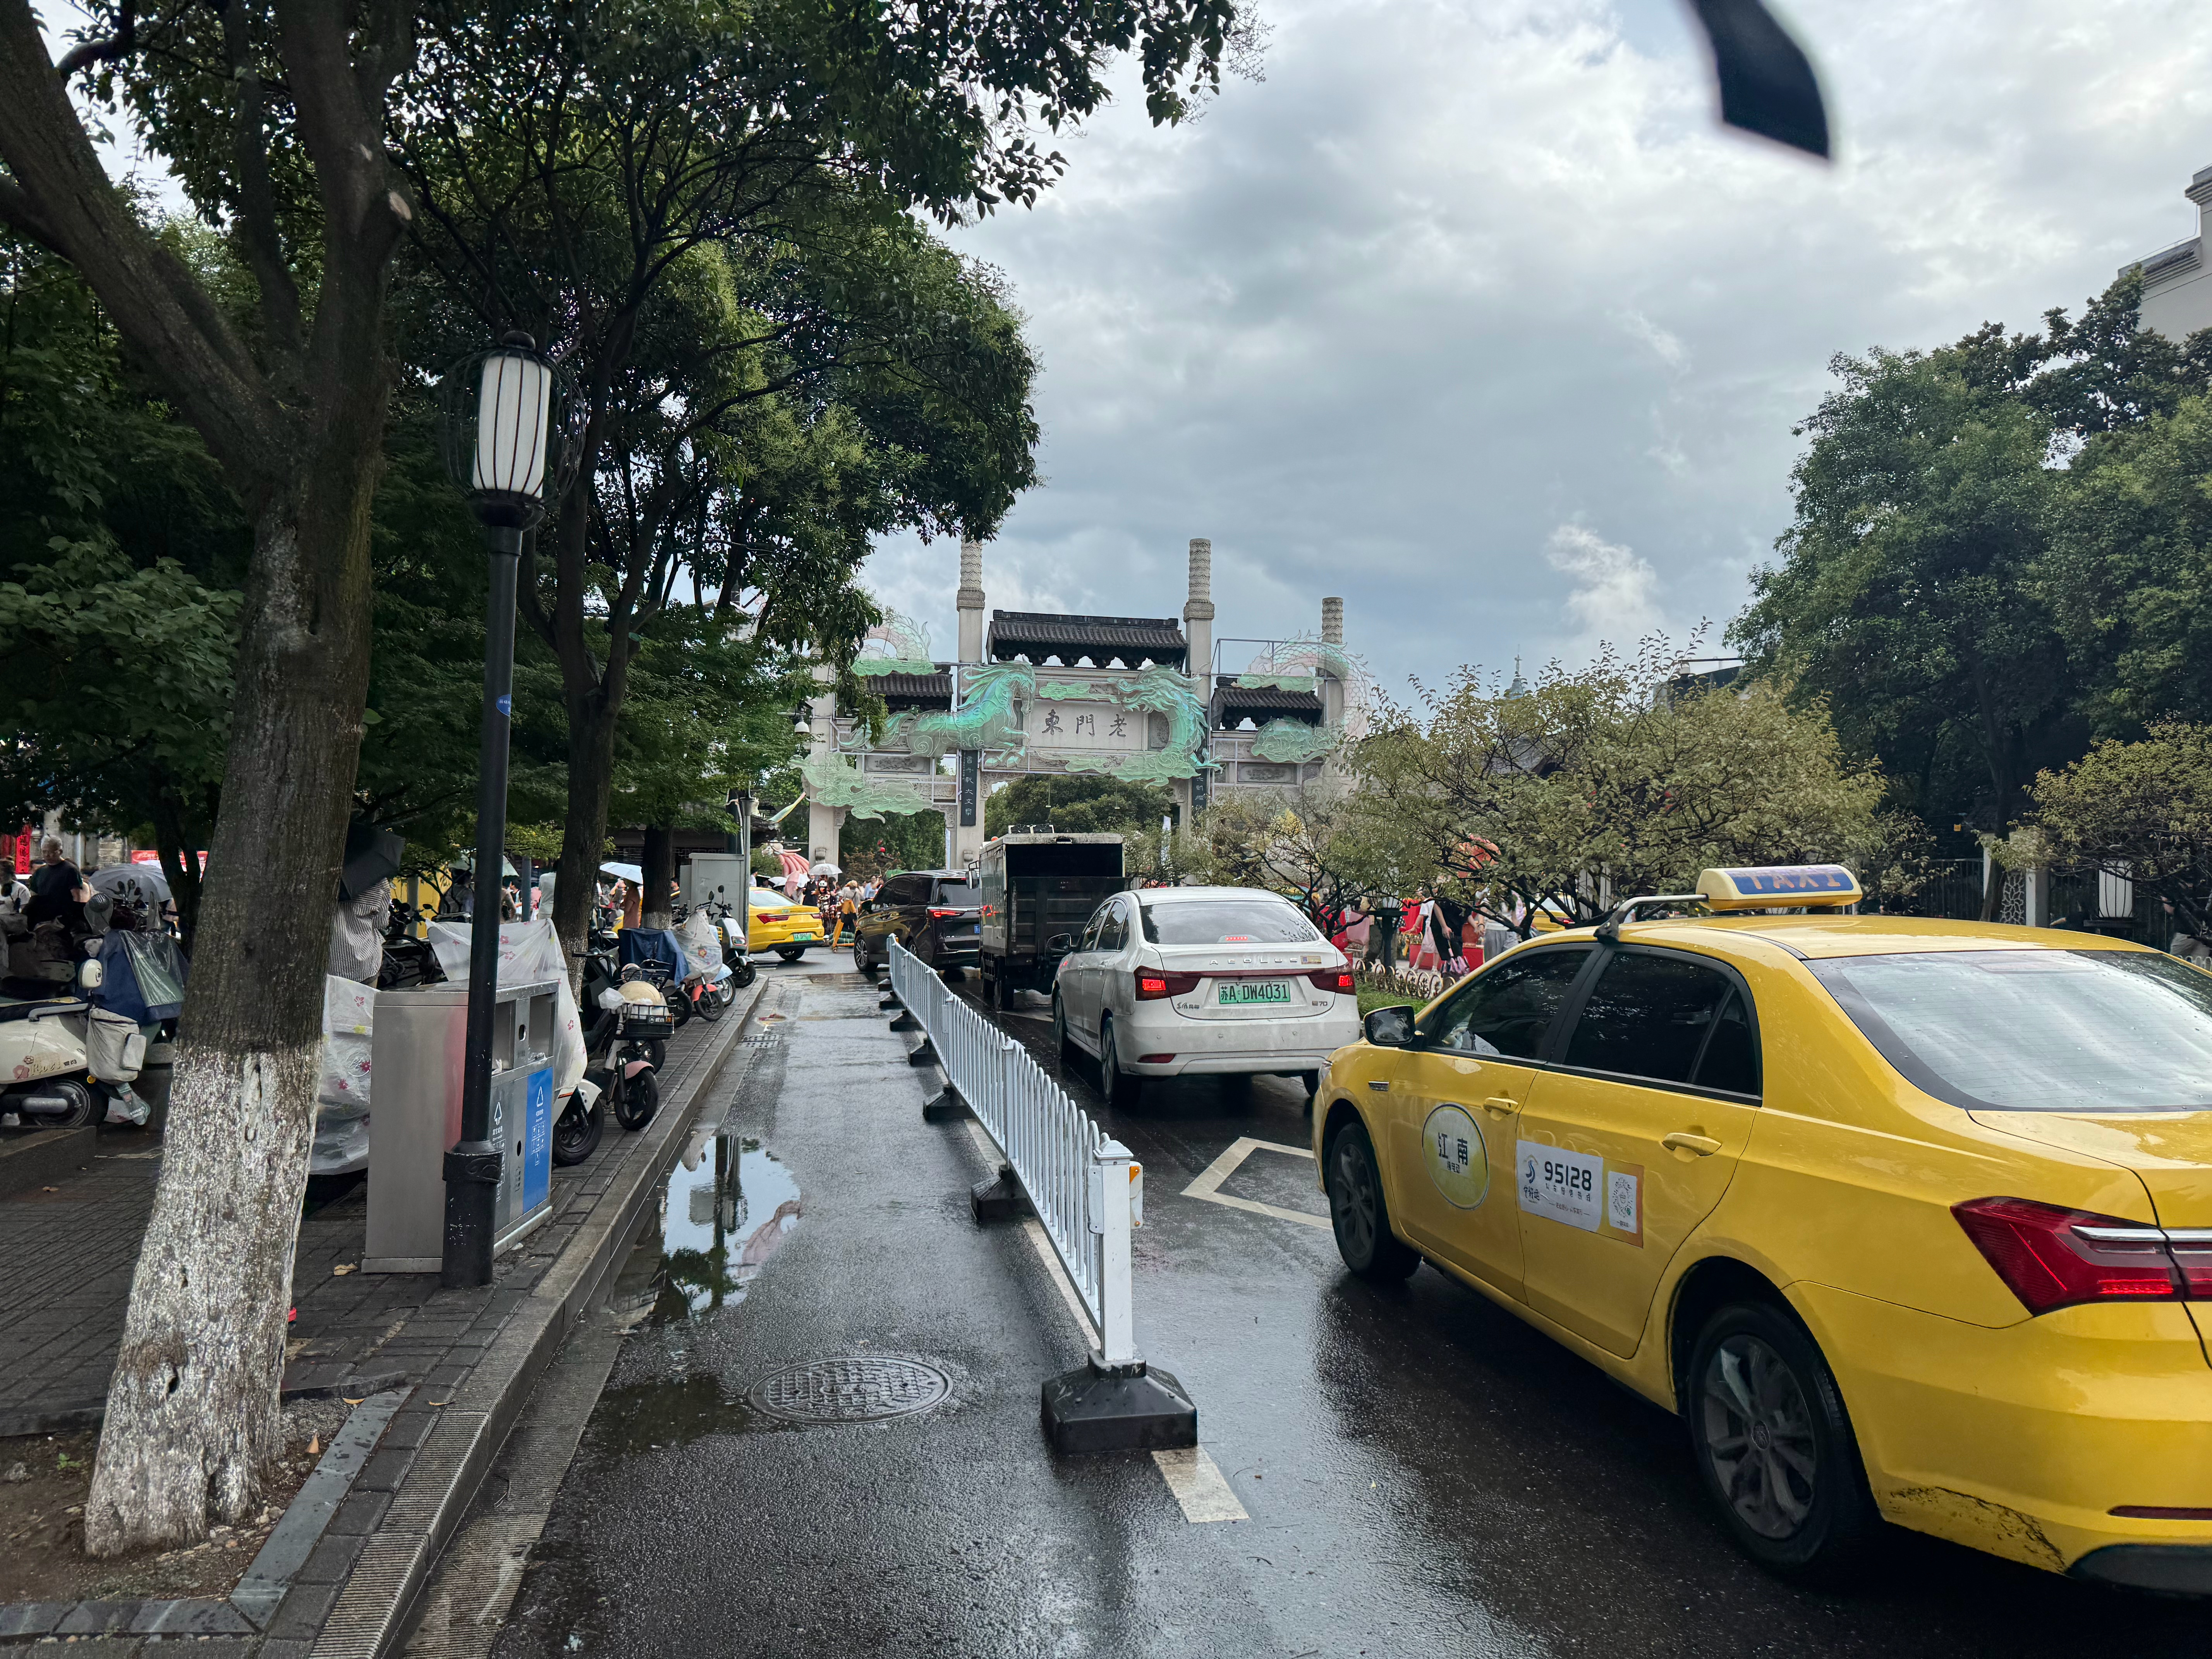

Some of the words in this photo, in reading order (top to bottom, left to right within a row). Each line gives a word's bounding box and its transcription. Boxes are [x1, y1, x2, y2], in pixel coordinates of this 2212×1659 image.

[1744, 869, 1841, 890] TAXI
[1242, 984, 1288, 1000] DW4031
[1438, 1132, 1468, 1166] 江南
[1544, 1161, 1592, 1192] 95128
